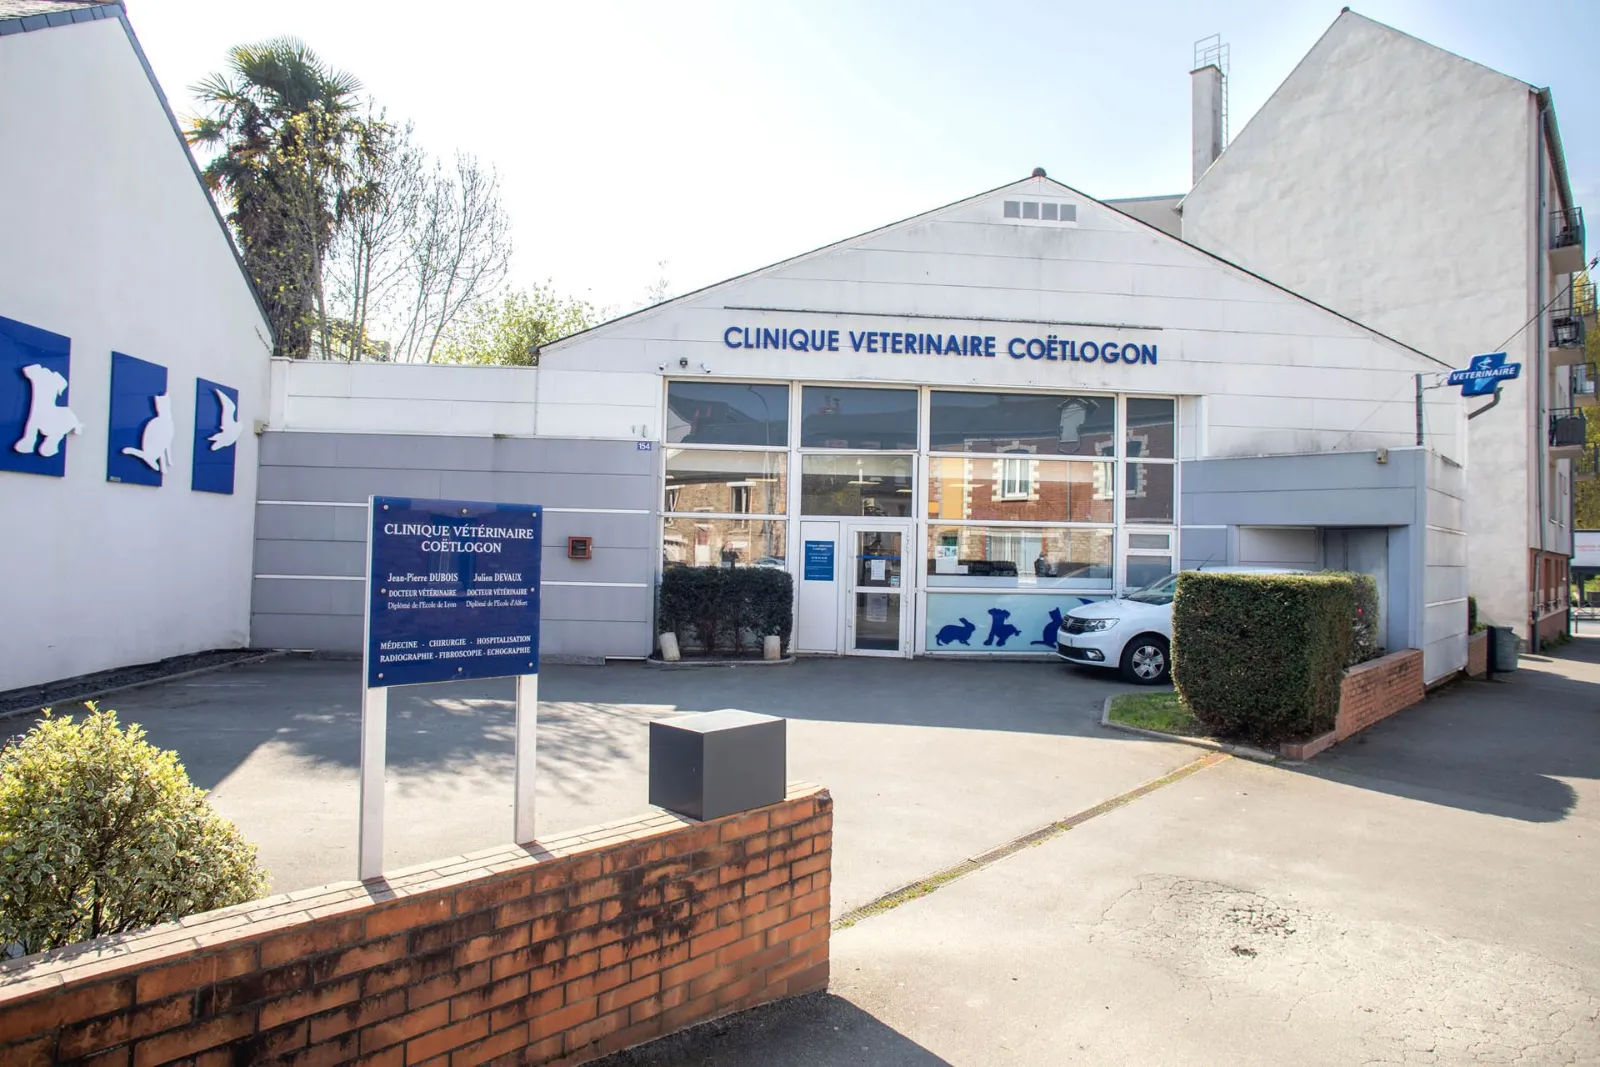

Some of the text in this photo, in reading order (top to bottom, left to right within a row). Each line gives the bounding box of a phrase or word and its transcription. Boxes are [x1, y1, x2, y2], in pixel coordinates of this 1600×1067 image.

[724, 326, 1157, 365] CLINIQUE VETERINAIRE COËTLOGON
[384, 523, 534, 539] CLINIQUE VÉTÉRINAIRE
[421, 539, 502, 553] COËTLOGON
[387, 573, 459, 582] Jean-Pierre DUBOIS
[473, 573, 522, 582] Julien DEVAUX
[388, 588, 457, 597] DOCTEUR VÉTÉRINAIRE
[466, 587, 528, 596] DOCTEUR VÉTÉRINAIRE
[380, 640, 418, 650] MÉDECINE
[429, 638, 466, 648] CHIRURGIE
[476, 635, 531, 645] HOSPITALISATION
[380, 652, 434, 663] RADIOGRAPHIE
[439, 649, 482, 659] FIBROSCOPIE
[487, 646, 531, 656] ECHOGRAPHIE
